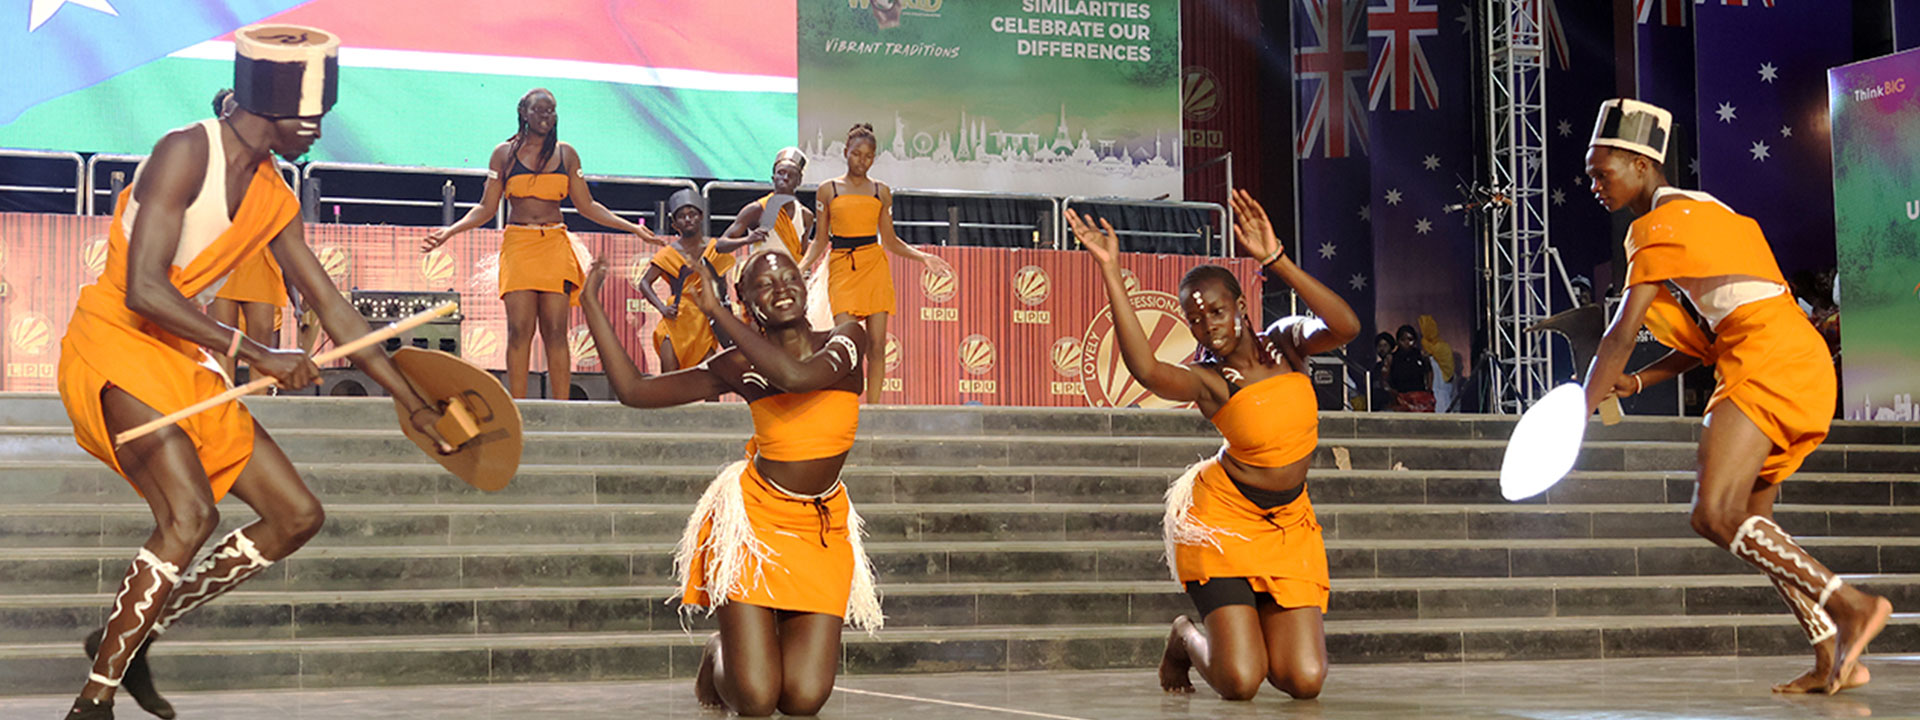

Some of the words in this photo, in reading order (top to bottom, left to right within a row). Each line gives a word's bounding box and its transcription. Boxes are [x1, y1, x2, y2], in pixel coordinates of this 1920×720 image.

[1022, 0, 1151, 20] SIMILARITIES
[991, 16, 1105, 38] CELEBRATE
[1108, 23, 1150, 41] OUR
[1017, 39, 1151, 62] DIFFERENCES
[1190, 131, 1222, 146] PU
[922, 309, 957, 320] LPU
[1015, 311, 1049, 323] LPU
[1083, 331, 1101, 381] LOVELY
[8, 364, 52, 377] LPU
[961, 381, 995, 392] LPU
